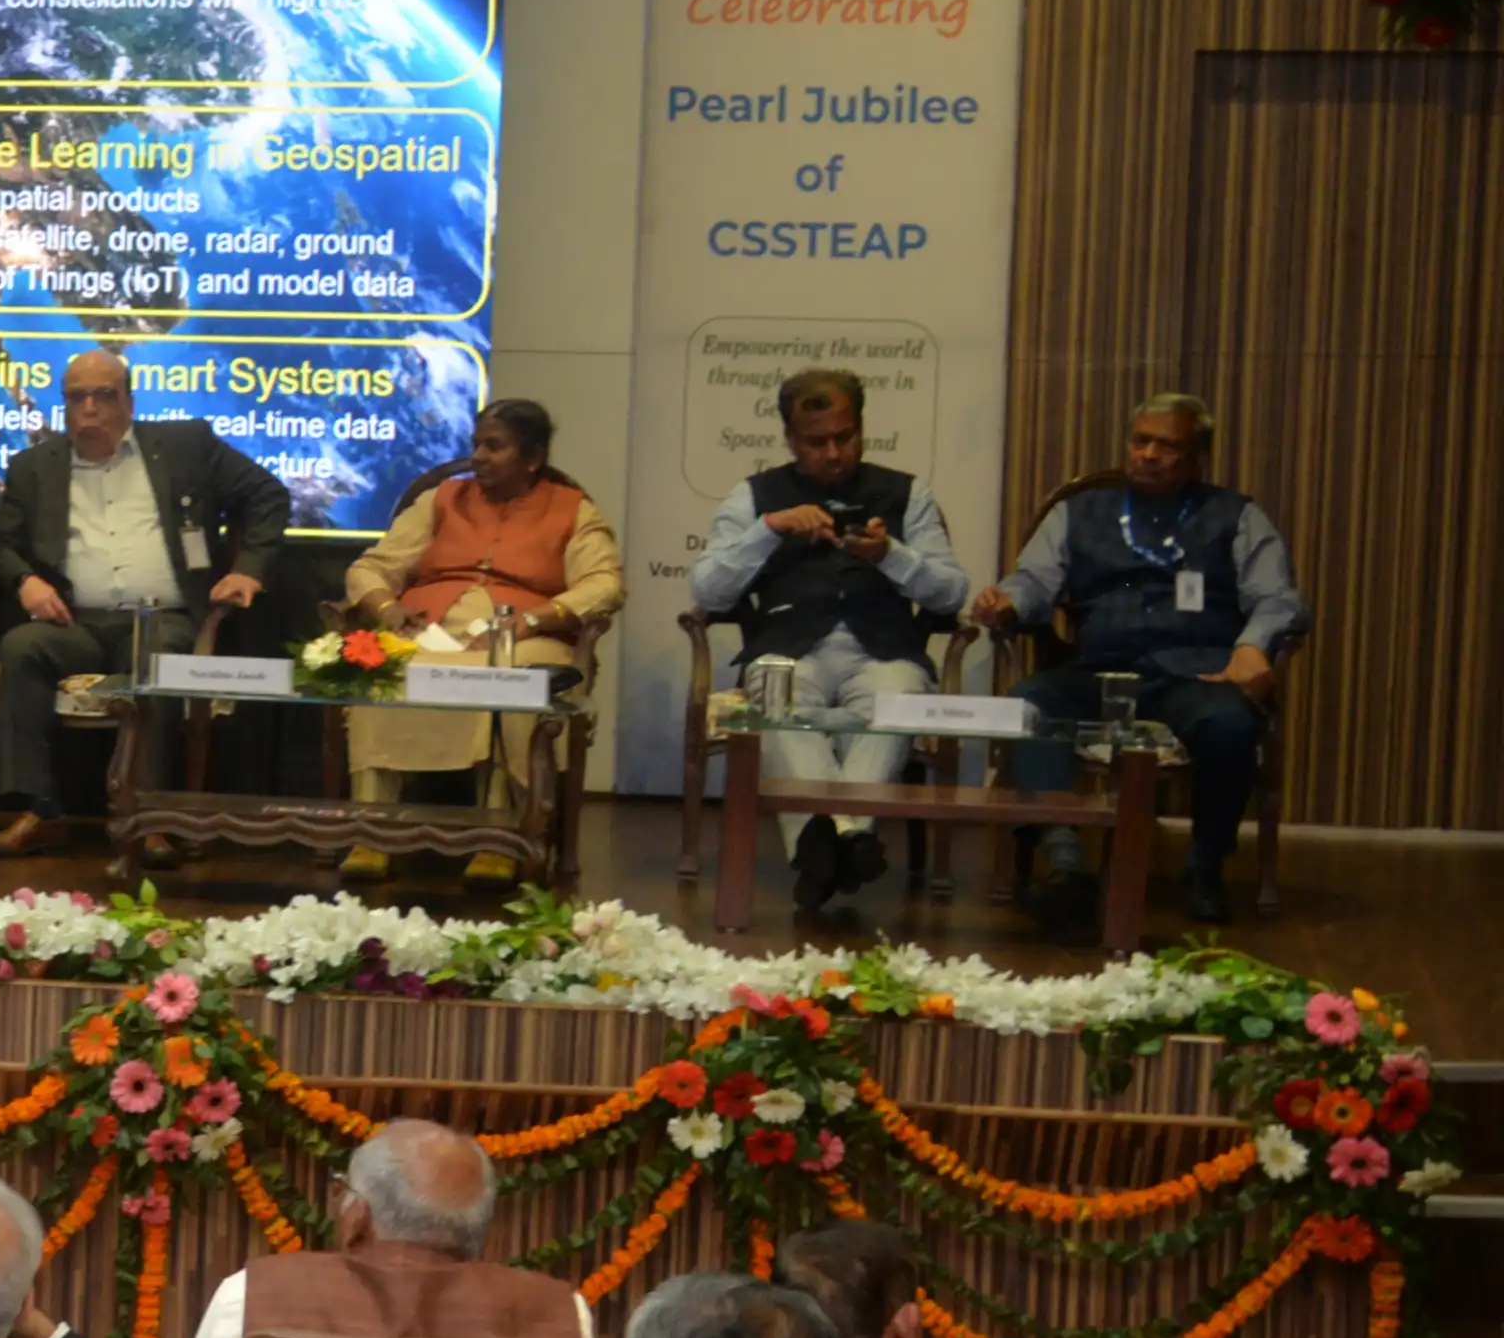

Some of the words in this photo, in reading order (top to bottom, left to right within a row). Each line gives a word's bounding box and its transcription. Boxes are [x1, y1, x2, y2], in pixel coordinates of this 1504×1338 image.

[668, 86, 786, 122] Pearl
[802, 87, 978, 125] Jubilee
[30, 135, 193, 178] Learning
[255, 135, 459, 180] Geospatial
[796, 155, 845, 193] of
[81, 187, 199, 217] products
[109, 226, 197, 257] drone,
[206, 228, 286, 258] radar,
[295, 228, 393, 260] ground
[708, 220, 927, 261] CSSTEAP
[27, 264, 114, 296] Things
[122, 265, 189, 298] (IoT)
[197, 267, 249, 296] and
[258, 268, 344, 298] model
[352, 269, 414, 299] data
[702, 334, 825, 362] Empowering
[829, 337, 861, 359] the
[866, 340, 925, 360] world
[228, 353, 393, 401] Systems
[895, 369, 915, 392] in
[333, 415, 394, 442] data
